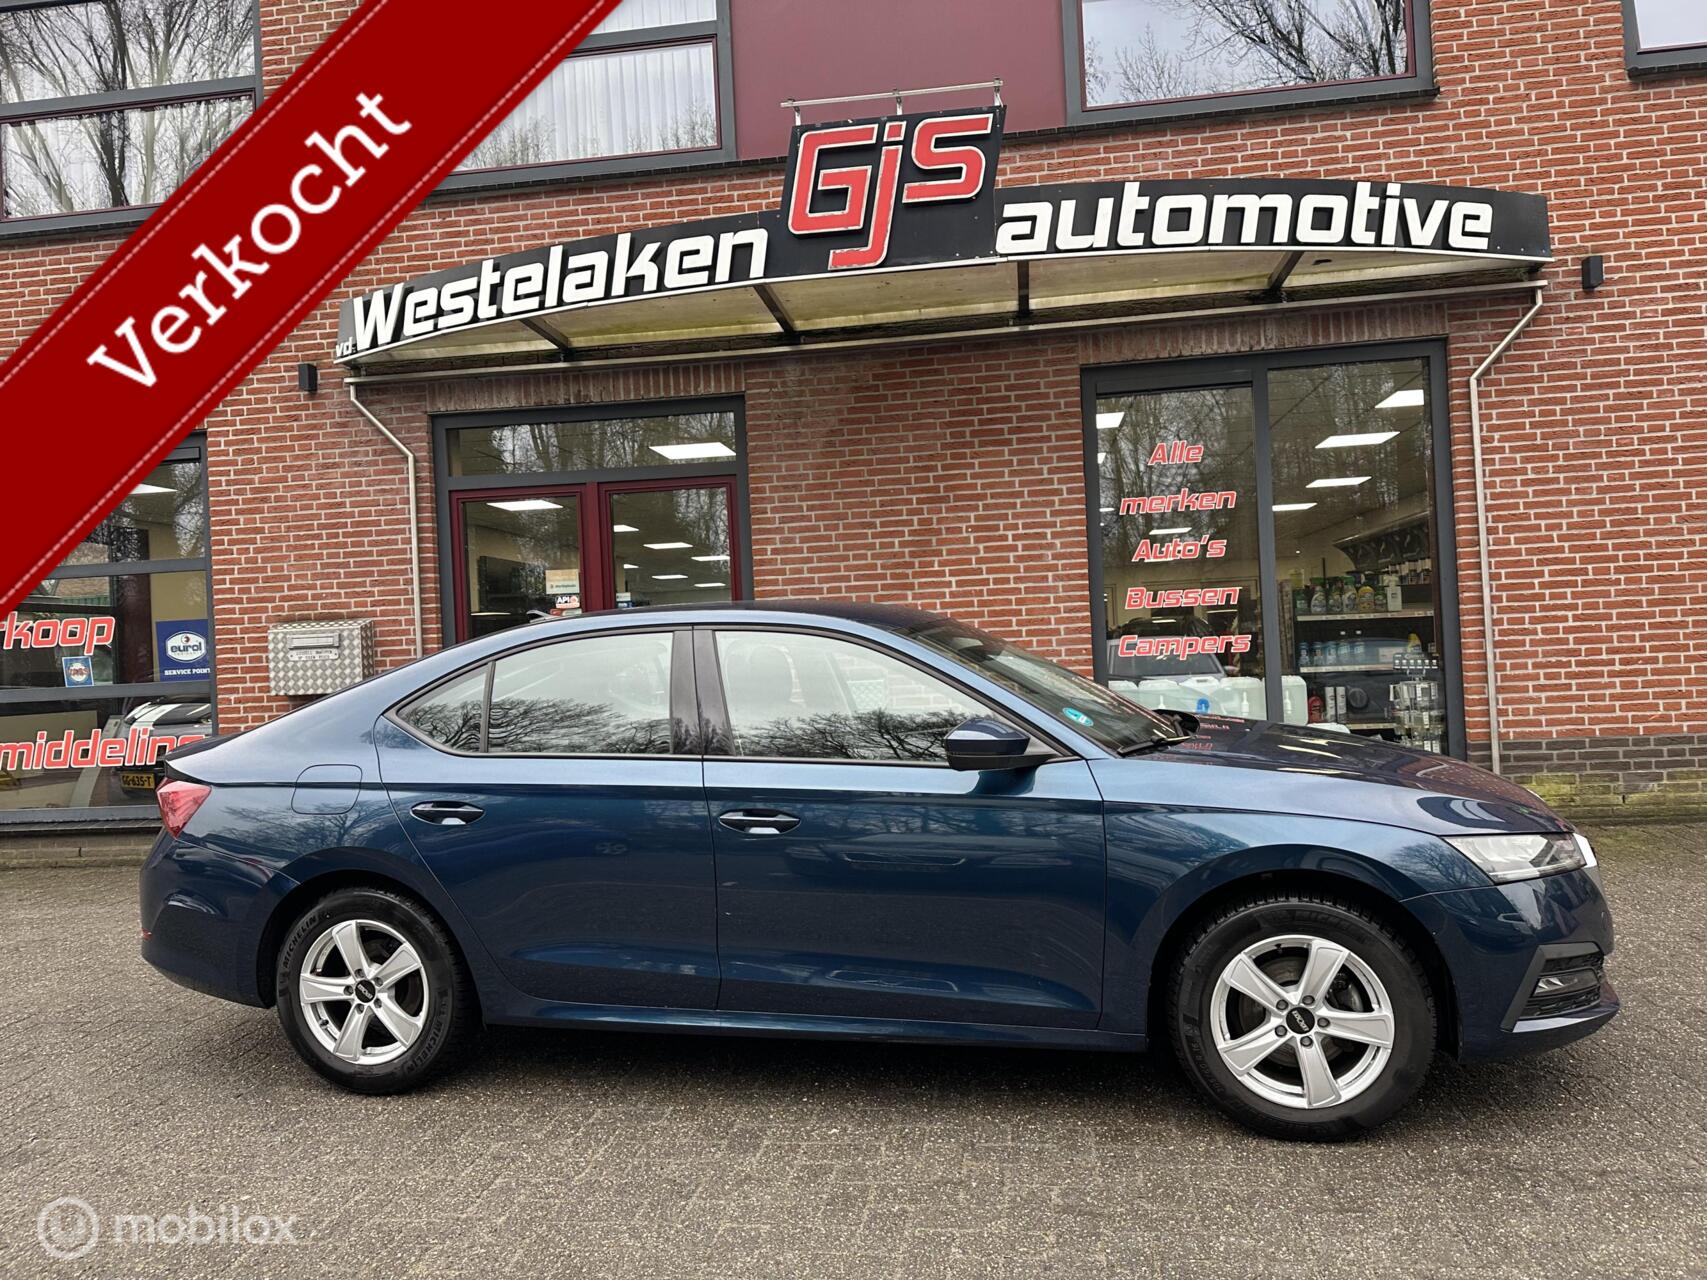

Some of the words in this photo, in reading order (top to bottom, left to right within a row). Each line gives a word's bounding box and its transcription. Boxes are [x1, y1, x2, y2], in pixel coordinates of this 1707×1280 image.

[995, 181, 1493, 254] automotive
[354, 227, 768, 350] Westelaken
[1147, 440, 1204, 466] Alle
[1119, 487, 1237, 516] merken
[1131, 535, 1227, 562] Auto's
[1124, 586, 1240, 610] Bussen
[171, 642, 202, 652] eurol
[1118, 634, 1252, 661] Campers
[283, 915, 317, 969] MICHELIN
